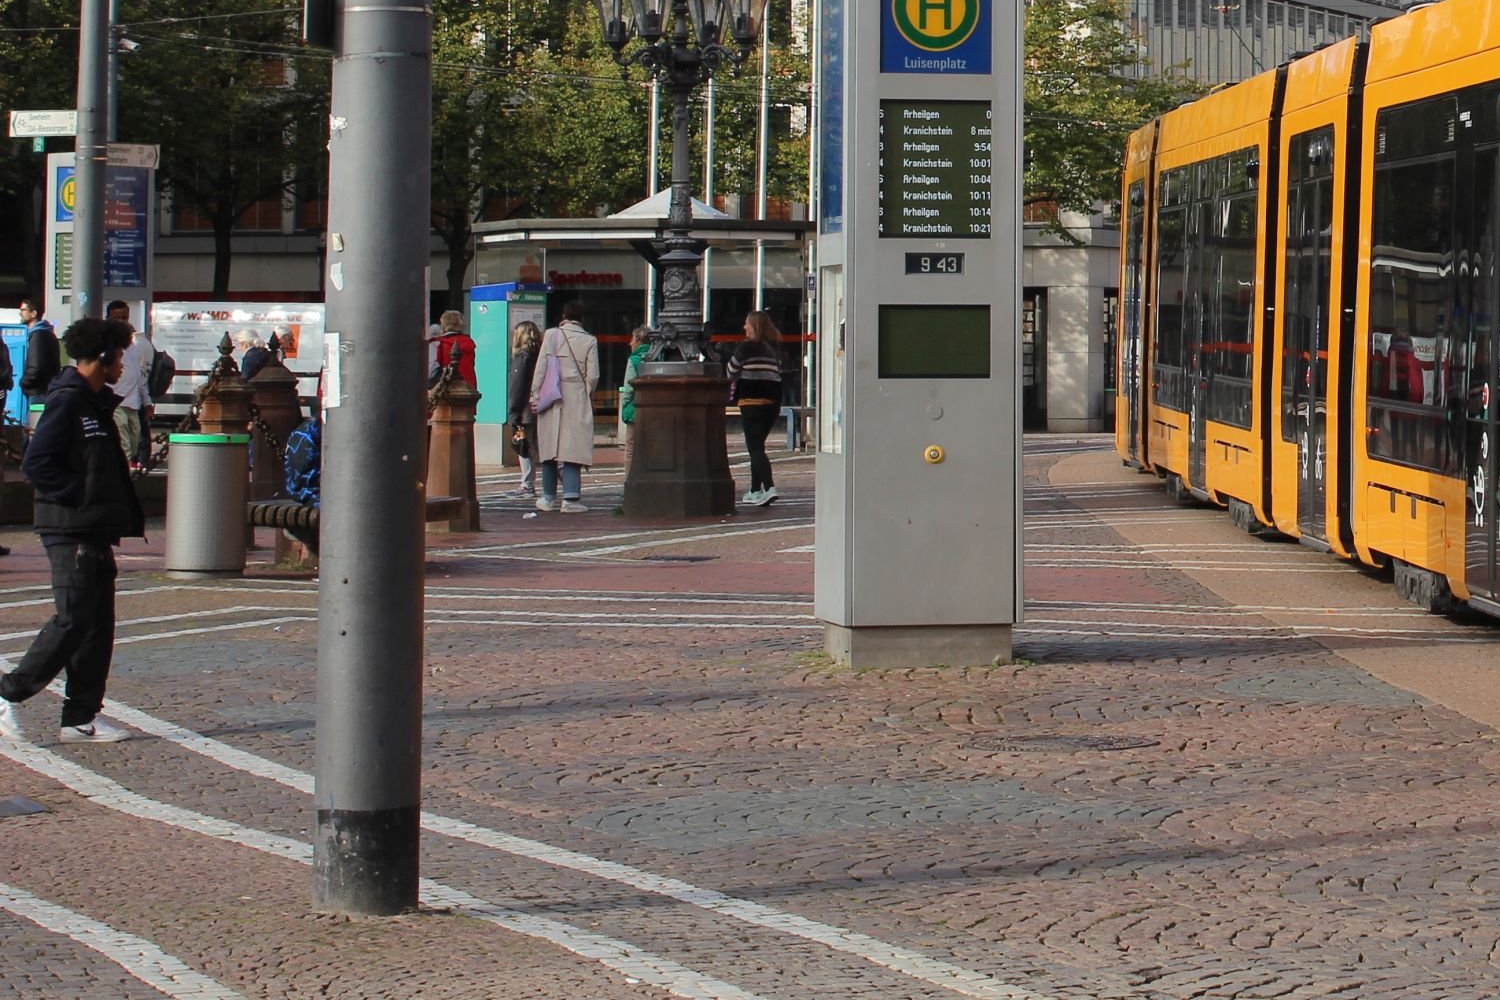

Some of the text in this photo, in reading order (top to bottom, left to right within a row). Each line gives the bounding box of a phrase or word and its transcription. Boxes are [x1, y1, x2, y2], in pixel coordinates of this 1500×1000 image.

[904, 56, 967, 72] Luisenplatz
[903, 109, 940, 121] Arheilgen
[903, 125, 953, 135] Kranichstein
[970, 126, 976, 136] 8
[977, 126, 992, 136] min
[903, 142, 940, 153] Arheilgen
[974, 142, 992, 152] 9:54
[903, 158, 953, 168] Kranichstein
[969, 158, 992, 168] 10:01
[903, 174, 940, 186] Arheilgen
[969, 174, 992, 184] 10:04
[903, 190, 953, 200] Kranichstein
[969, 190, 992, 200] 10:11
[903, 207, 940, 219] Arheilgen
[969, 207, 992, 217] 10:14
[903, 223, 953, 233] Kranichstein
[969, 223, 991, 233] 10:21
[548, 269, 624, 285] Sparkasse
